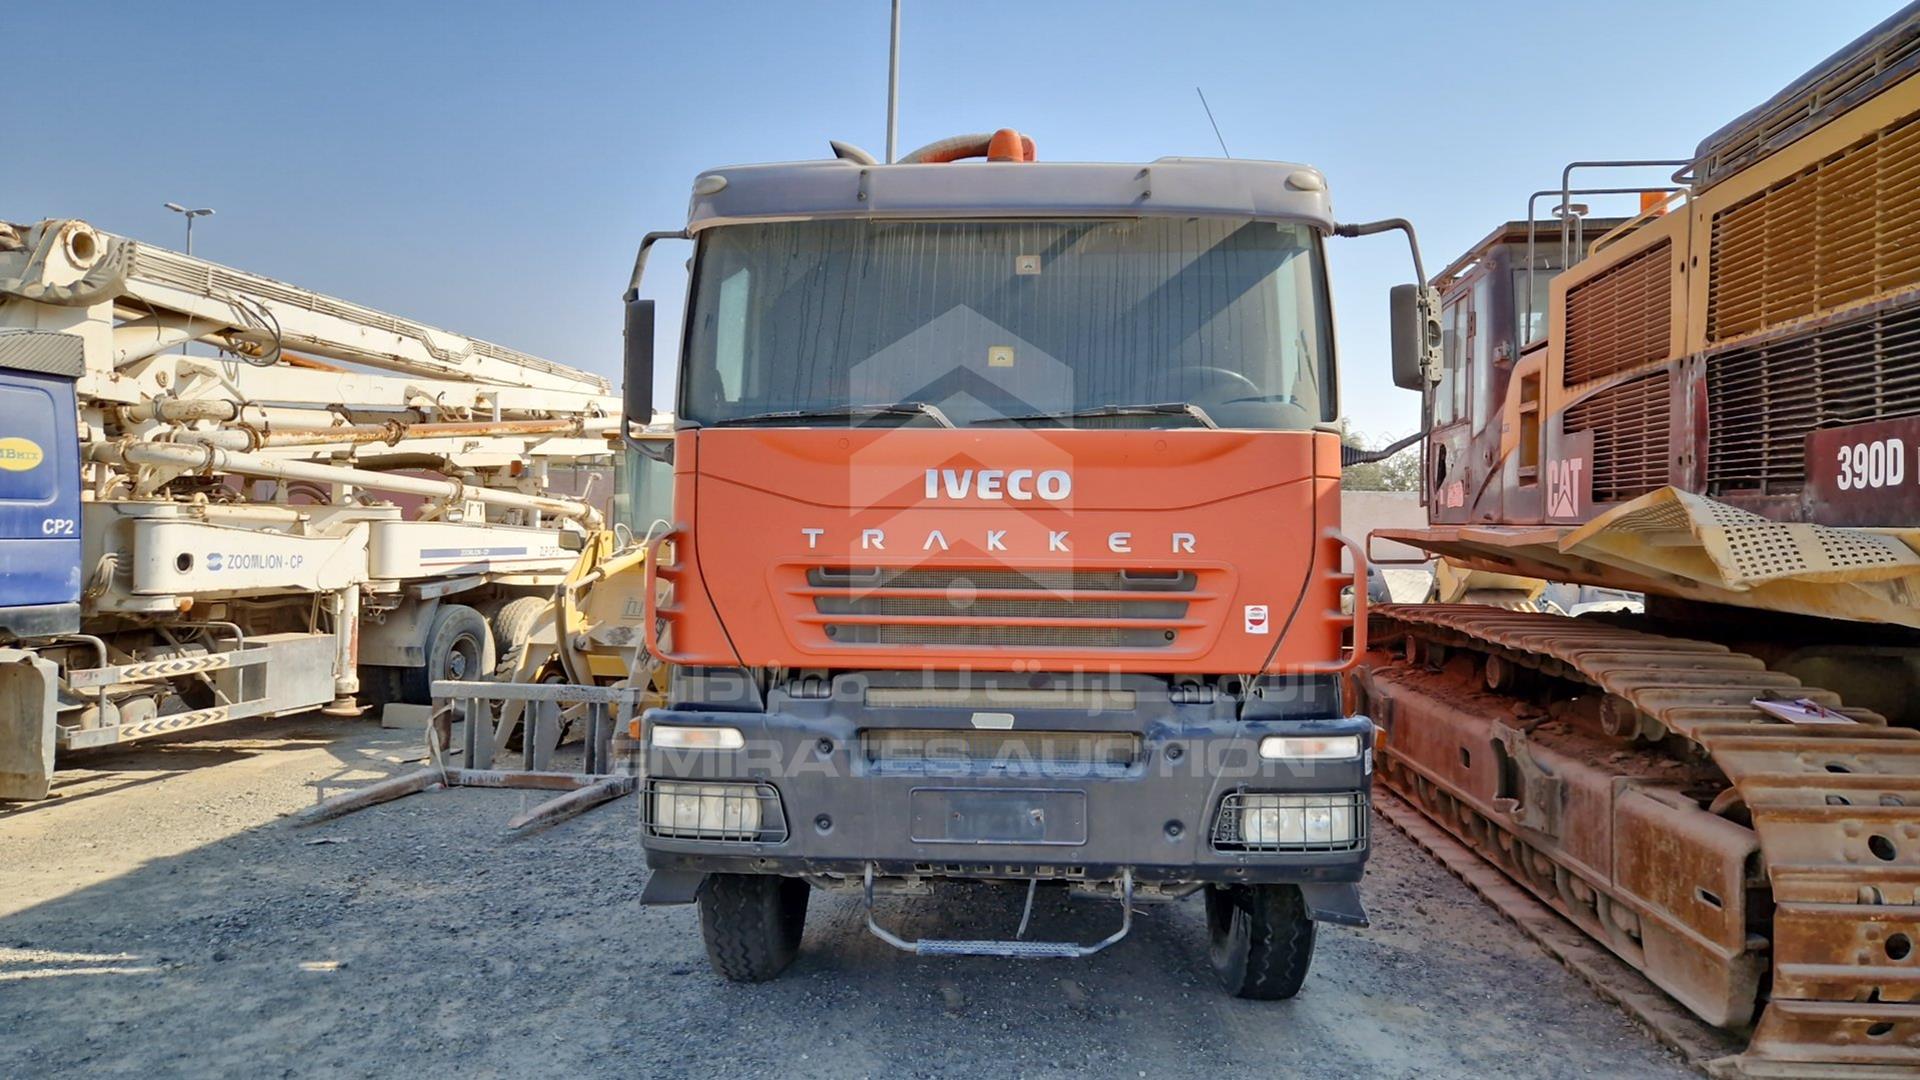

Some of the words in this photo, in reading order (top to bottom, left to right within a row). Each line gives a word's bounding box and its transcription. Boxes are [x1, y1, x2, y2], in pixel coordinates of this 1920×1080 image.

[1837, 439, 1904, 490] 390D
[924, 468, 1072, 500] IVECO
[1547, 458, 1582, 517] CAT
[42, 518, 74, 534] CP2
[801, 528, 1197, 553] TRAKKER
